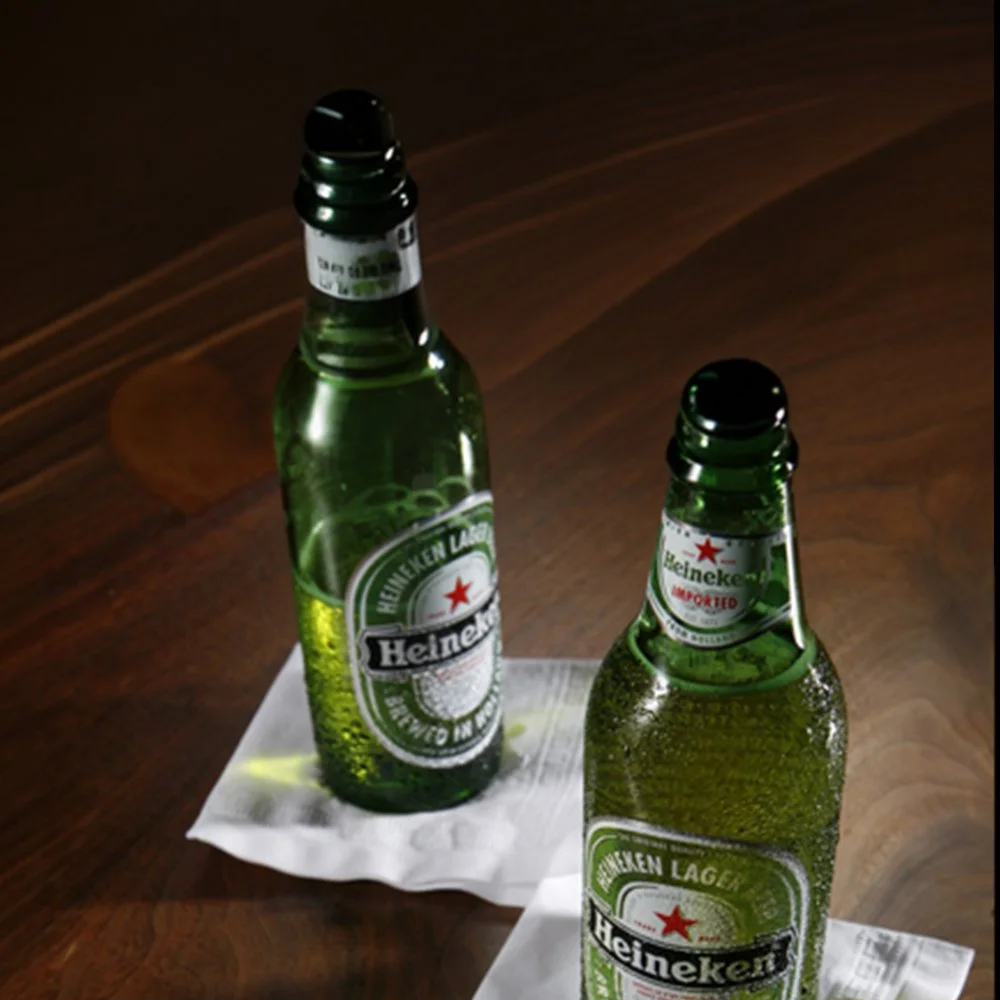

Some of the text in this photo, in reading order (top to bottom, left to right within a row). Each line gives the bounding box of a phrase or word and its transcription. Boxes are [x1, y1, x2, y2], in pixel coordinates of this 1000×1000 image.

[377, 540, 446, 615] HEINEKEN
[662, 550, 744, 588] Heineke
[671, 584, 738, 610] IMPORTED
[384, 695, 449, 746] BREWED
[596, 851, 664, 894] HEINEKEN
[592, 911, 778, 985] Heineken
